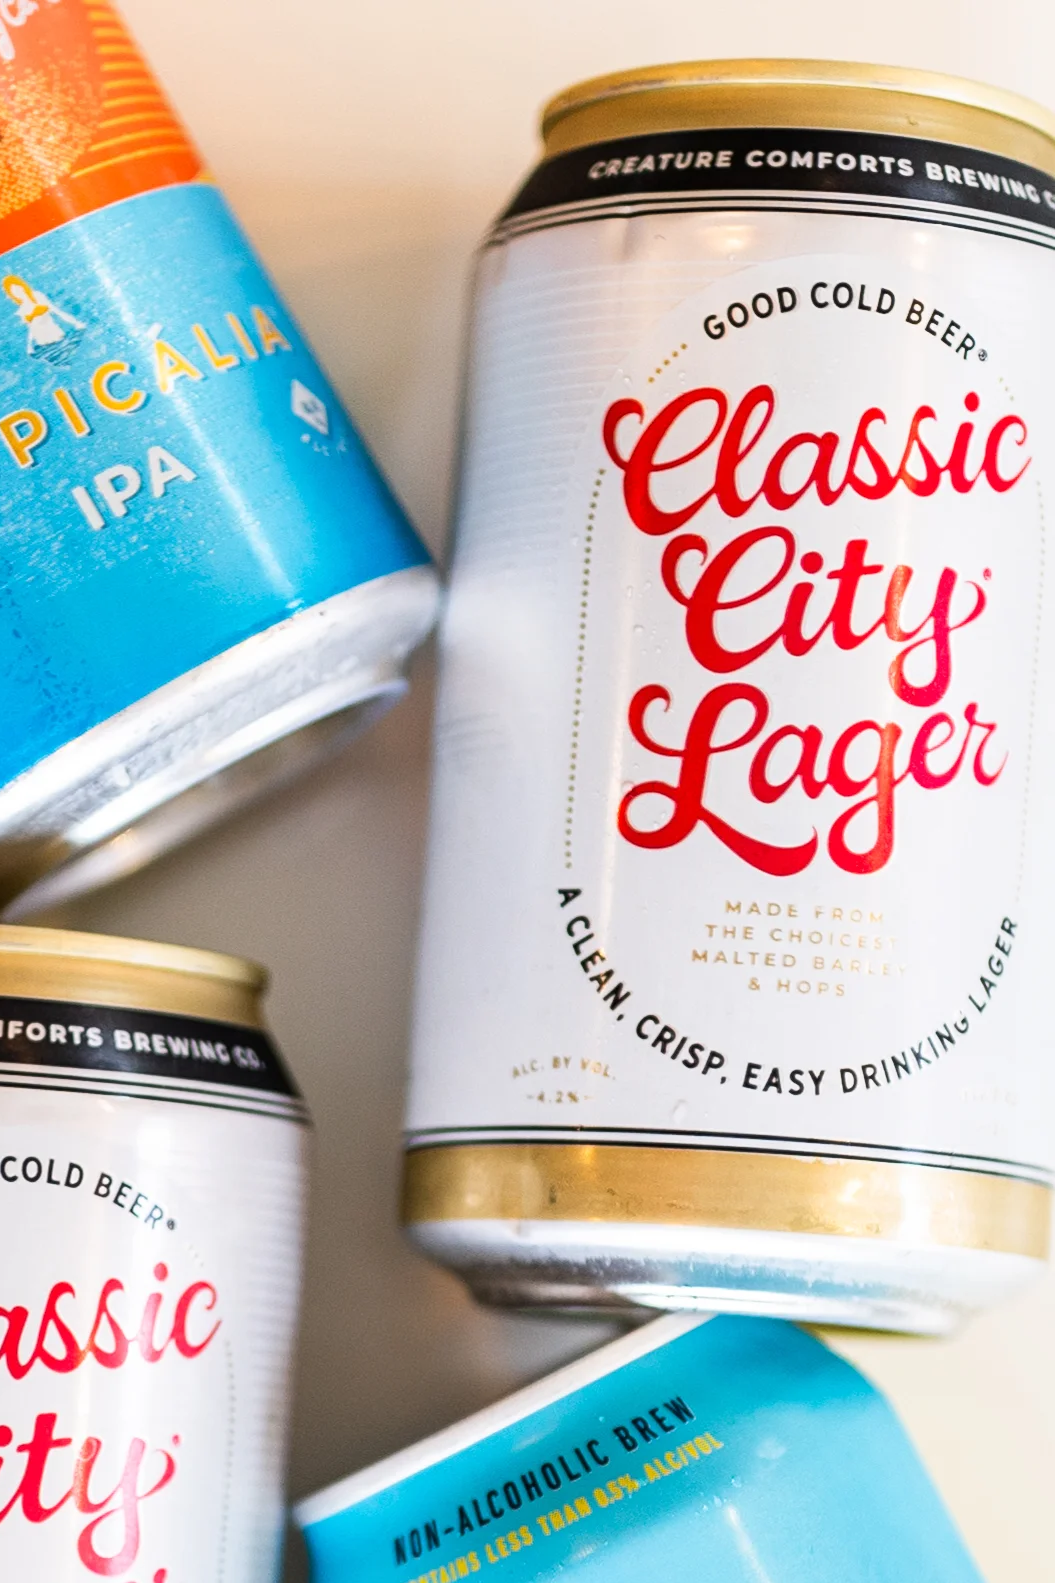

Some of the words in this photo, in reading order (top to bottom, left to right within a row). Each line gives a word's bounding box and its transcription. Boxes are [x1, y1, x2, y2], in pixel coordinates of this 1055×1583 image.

[588, 149, 734, 181] CREATURE
[745, 149, 915, 178] COMFORTS
[925, 160, 1043, 205] BREWING
[702, 284, 799, 341] GOOD
[810, 281, 897, 314] COLD
[71, 443, 199, 532] IPA
[601, 383, 1034, 537] Classic
[661, 525, 989, 707] City
[617, 682, 1010, 877] Lager
[557, 887, 583, 908] A
[725, 899, 798, 918] MADE
[814, 906, 884, 924] FROM
[564, 915, 632, 1022] CLEAN,
[691, 948, 797, 968] MALTED
[812, 956, 907, 977] BARLEY
[705, 923, 755, 941] THE
[769, 927, 899, 951] CHOICEST
[968, 916, 1020, 1015] LAGER
[748, 977, 760, 991] &
[776, 979, 846, 997] HOPS
[113, 1028, 230, 1065] BREWING
[634, 1012, 728, 1085] CRISP,
[742, 1062, 826, 1097] EASY
[840, 1009, 971, 1094] DRINKING
[0, 1155, 85, 1190] COLD
[391, 1437, 611, 1567] NON-ALCOHOLIC
[612, 1395, 697, 1454] BREW
[485, 1522, 535, 1565] LESS
[536, 1498, 592, 1539] THAN
[593, 1475, 641, 1510] 0.5%
